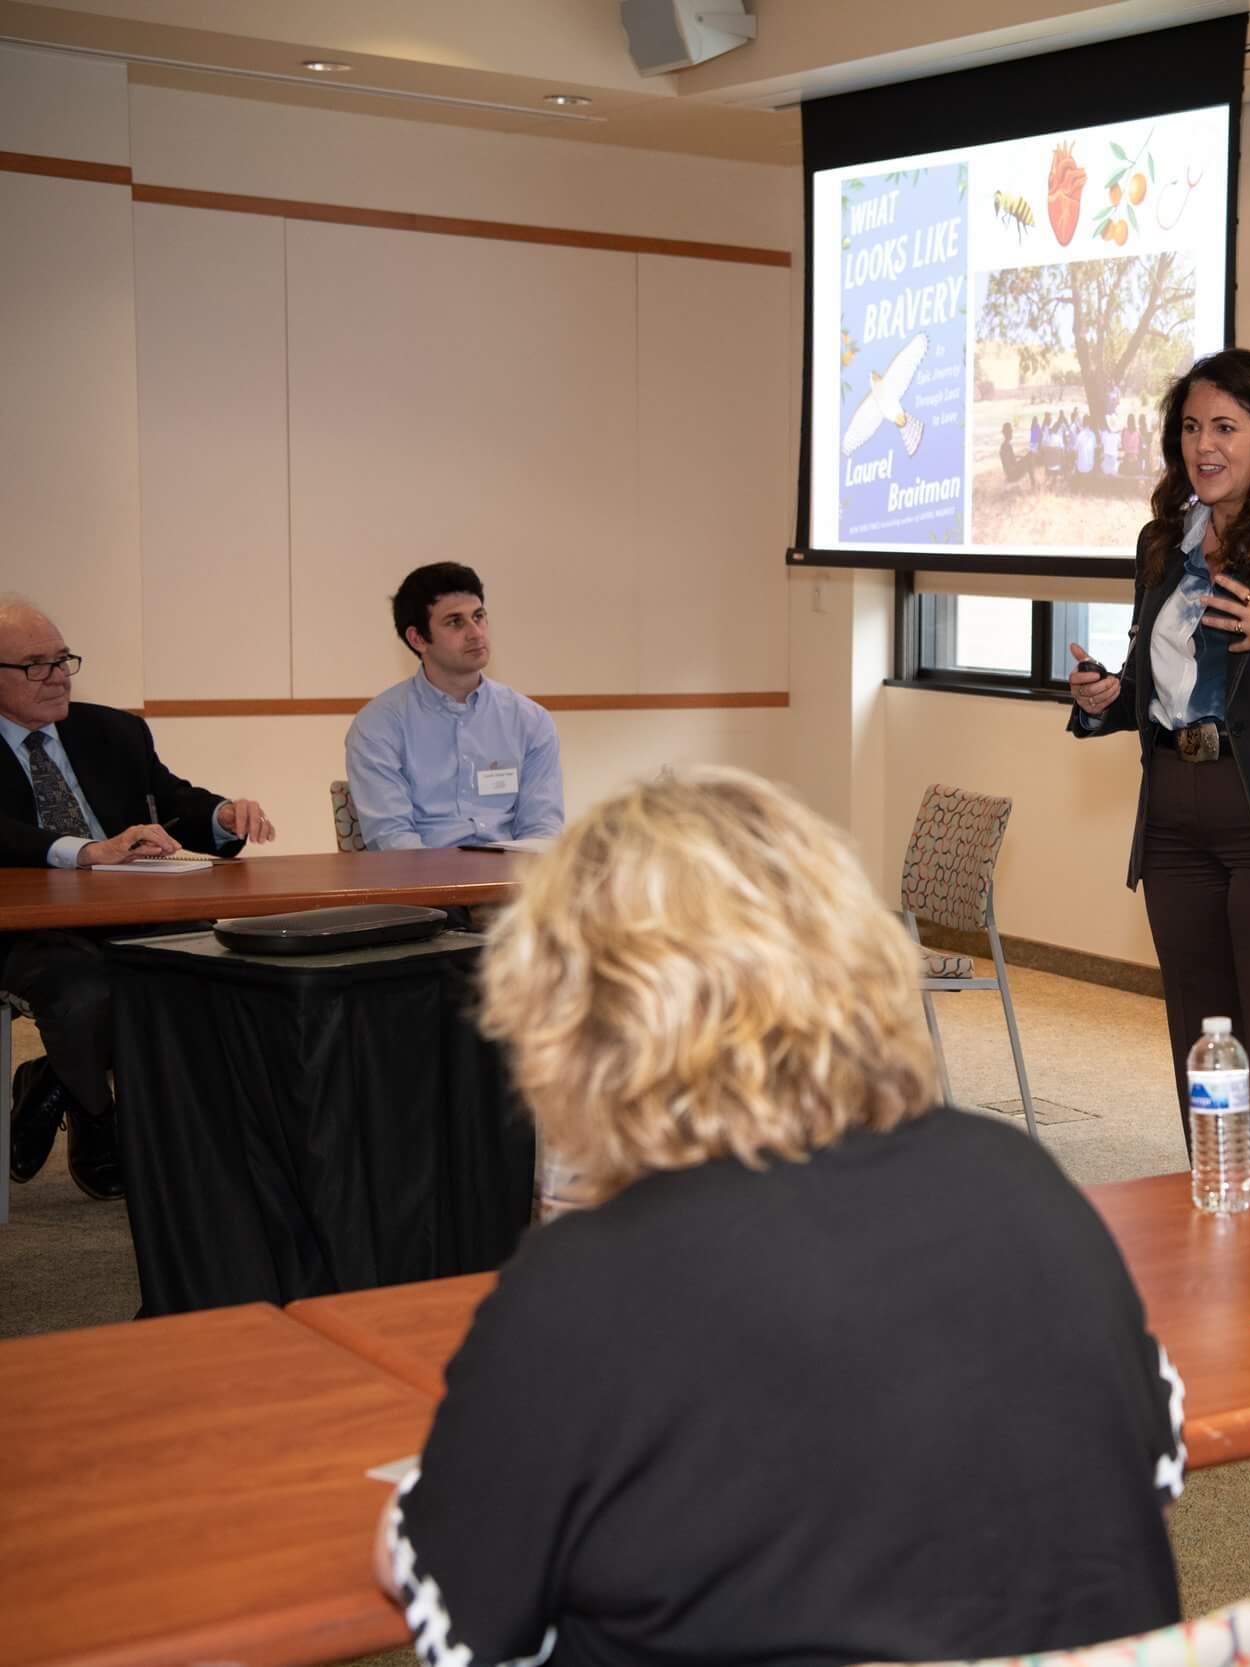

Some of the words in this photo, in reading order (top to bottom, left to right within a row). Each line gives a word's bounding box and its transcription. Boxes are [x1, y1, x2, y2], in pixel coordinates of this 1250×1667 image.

[851, 190, 899, 236] WHAT
[845, 234, 908, 289] LOOKS
[912, 217, 961, 268] LIKE
[863, 274, 963, 344] BRAVERY
[845, 449, 893, 487] Laurel
[887, 477, 960, 513] Braitman
